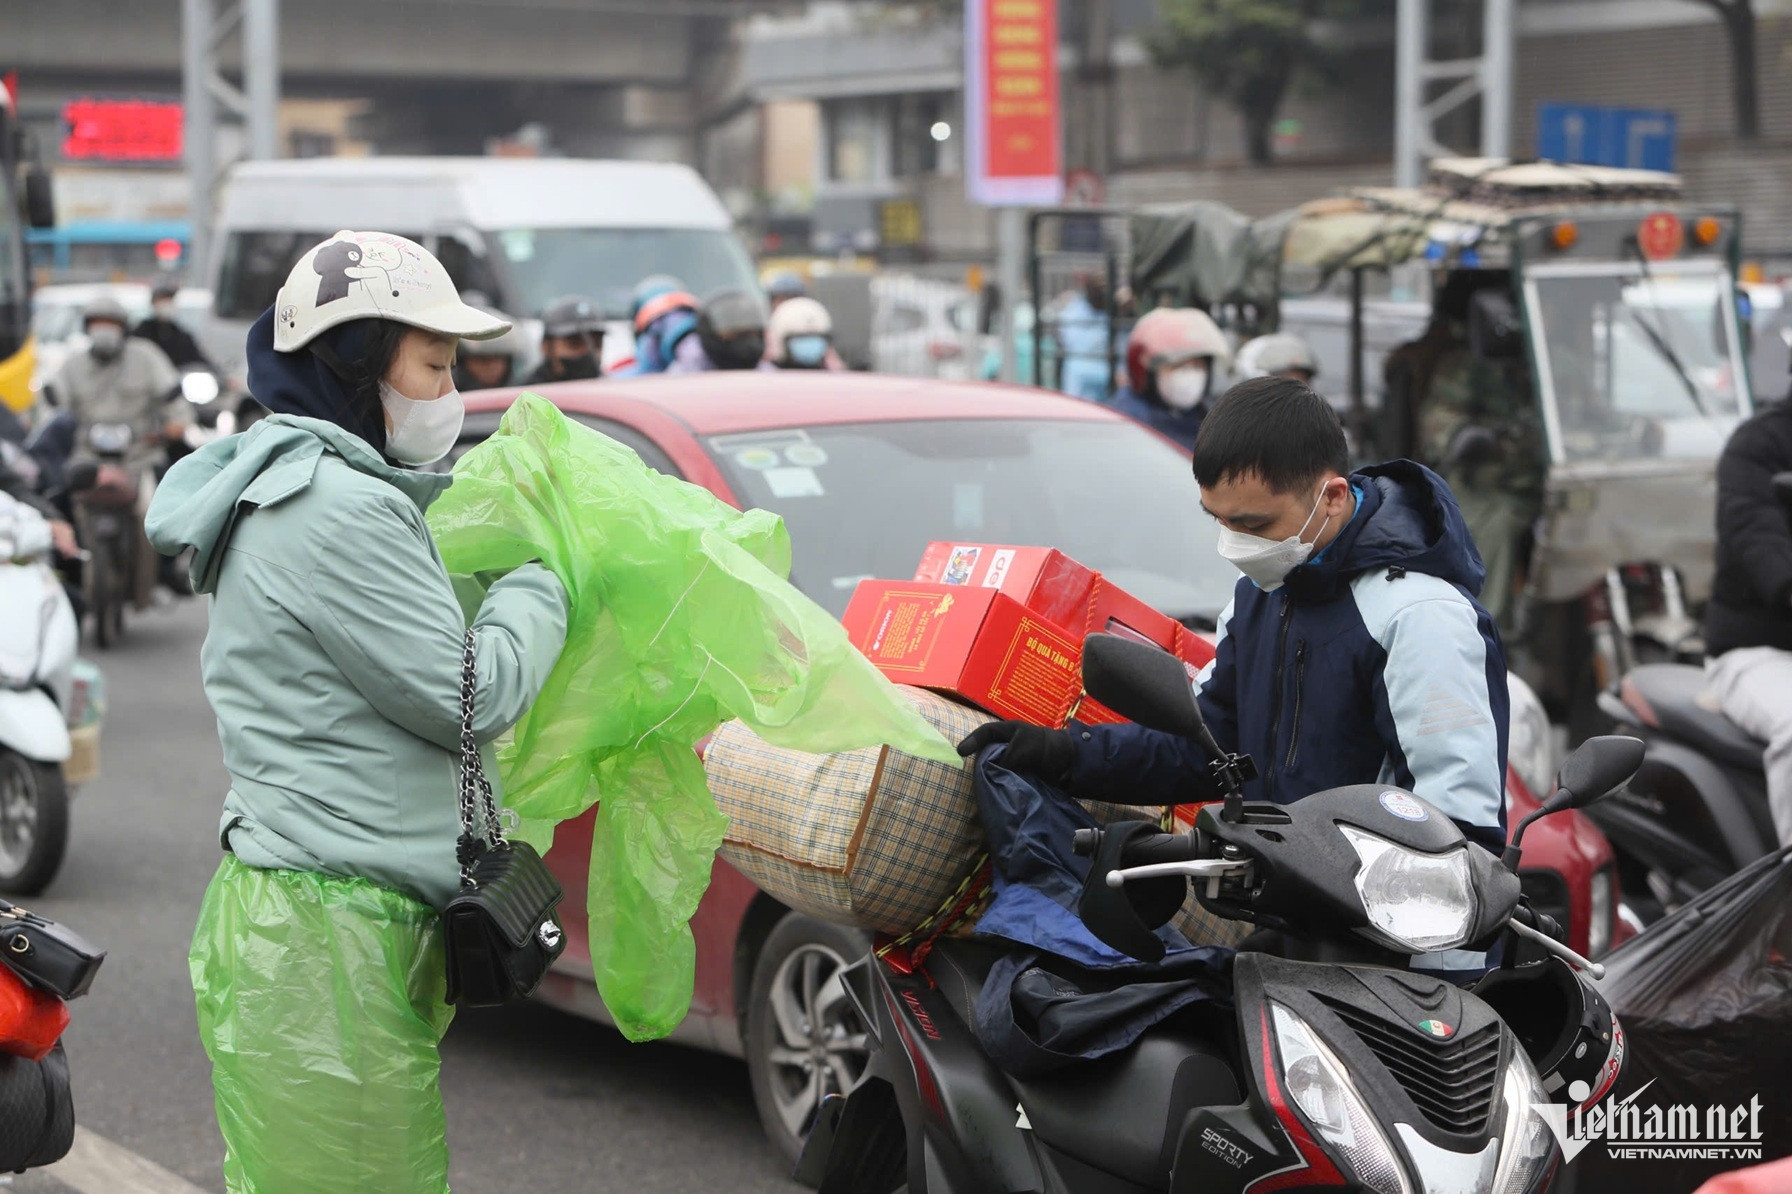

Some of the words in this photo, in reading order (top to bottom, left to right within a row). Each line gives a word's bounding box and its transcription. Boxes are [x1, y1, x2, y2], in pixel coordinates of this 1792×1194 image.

[877, 609, 893, 641] ORION
[1026, 637, 1038, 651] BỘ
[1036, 642, 1052, 659] QUÀ
[1051, 651, 1069, 670] TẶNG
[901, 991, 941, 1040] VISION
[1201, 1128, 1253, 1164] SPORTY
[1202, 1141, 1242, 1169] EDITION
